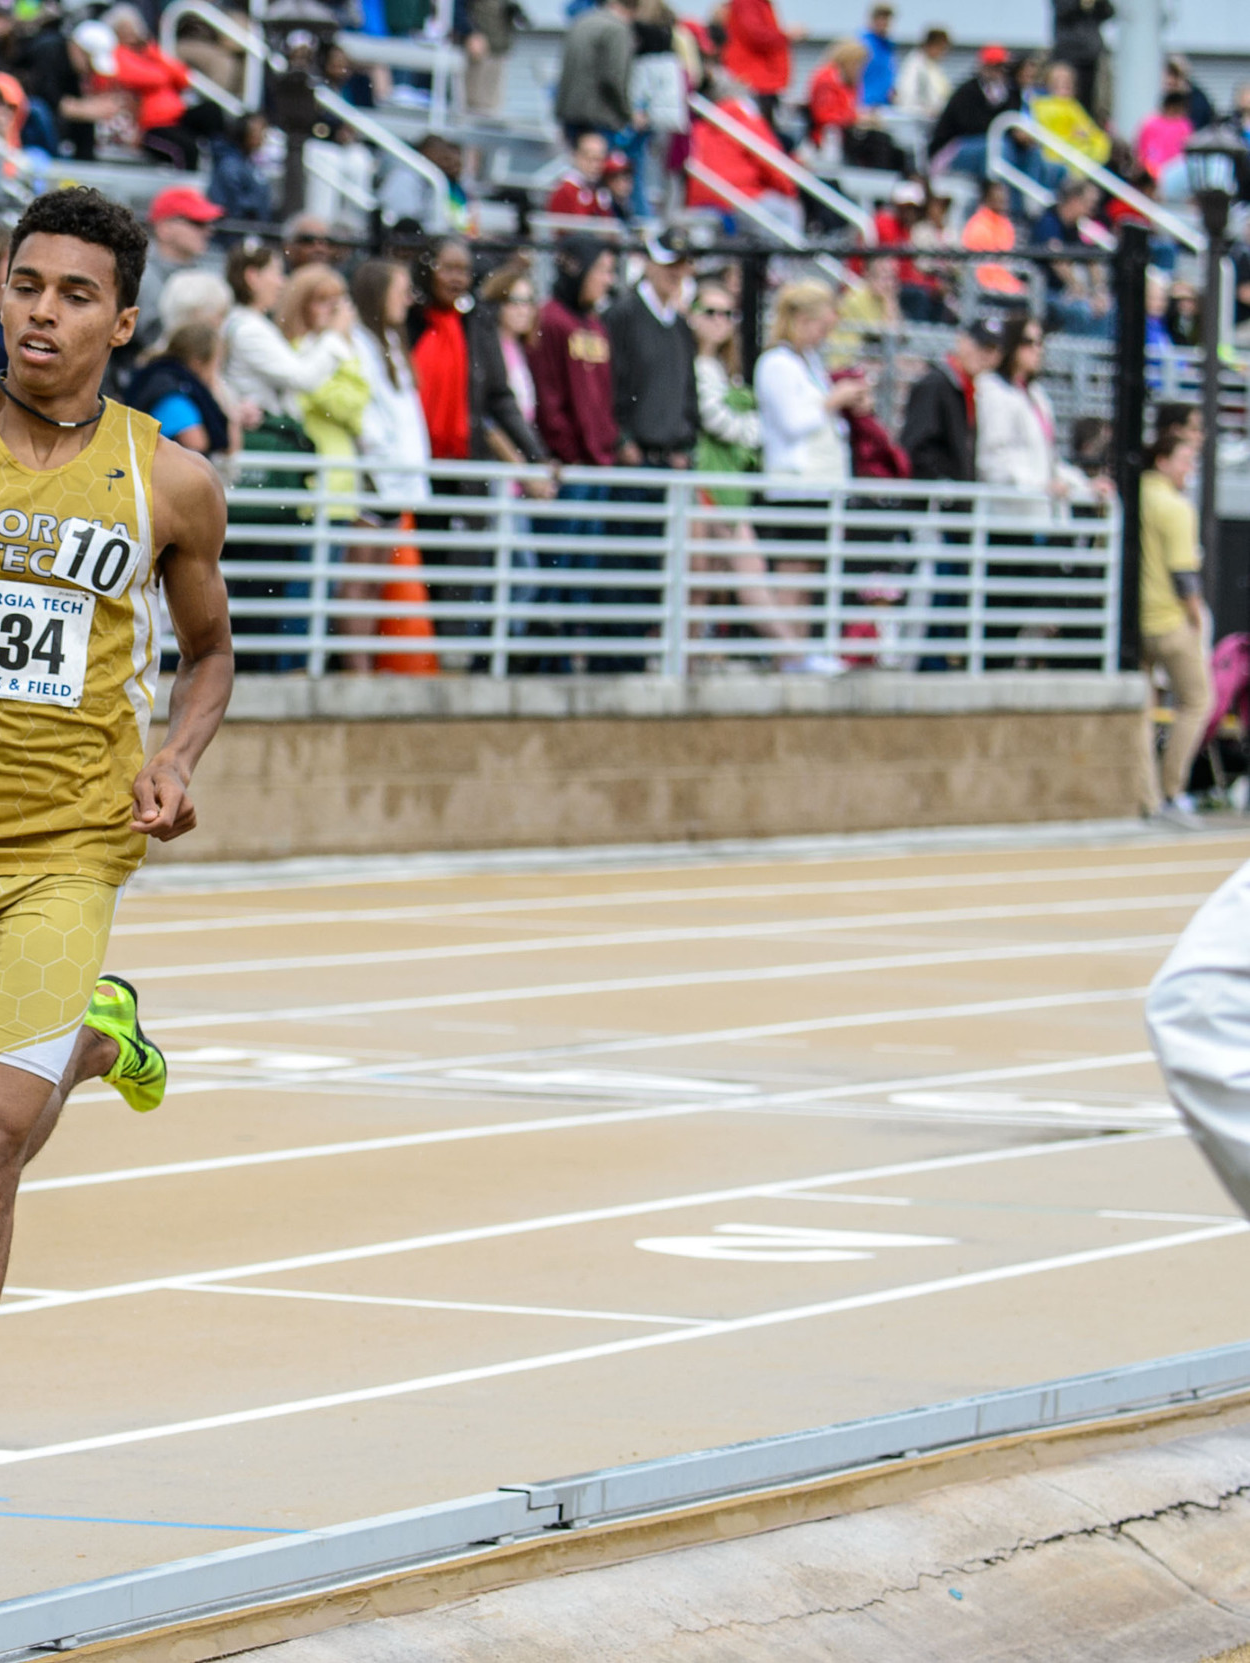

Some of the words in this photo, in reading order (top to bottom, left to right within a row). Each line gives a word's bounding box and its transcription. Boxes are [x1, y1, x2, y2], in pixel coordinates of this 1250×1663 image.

[66, 527, 130, 592] 10
[43, 598, 83, 615] TECH
[9, 678, 20, 691] &
[28, 681, 71, 697] FIELD
